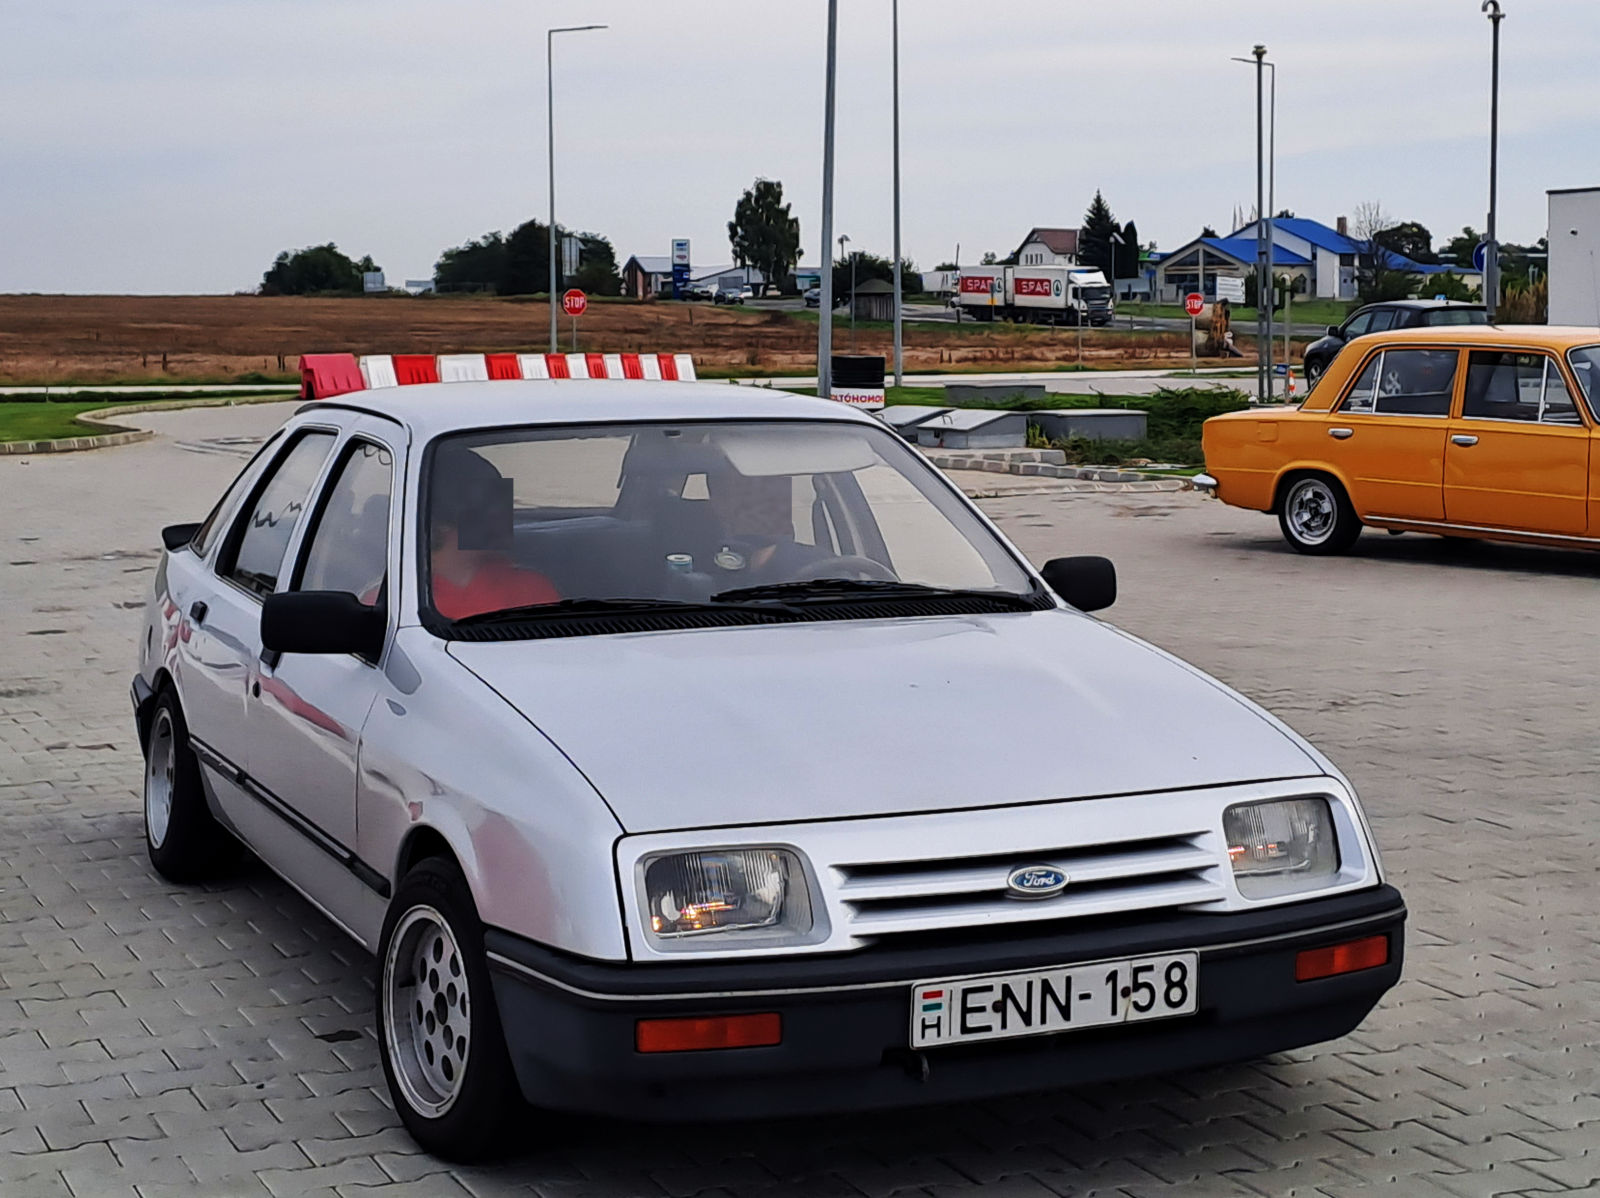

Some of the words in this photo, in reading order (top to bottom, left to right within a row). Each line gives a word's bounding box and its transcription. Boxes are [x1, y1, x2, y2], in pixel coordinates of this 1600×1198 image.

[1021, 280, 1050, 294] SPAR
[565, 296, 585, 309] STOP
[1186, 299, 1204, 309] STOP
[1023, 870, 1055, 887] Ford
[960, 960, 1188, 1035] ENN-158
[921, 1015, 941, 1040] H
